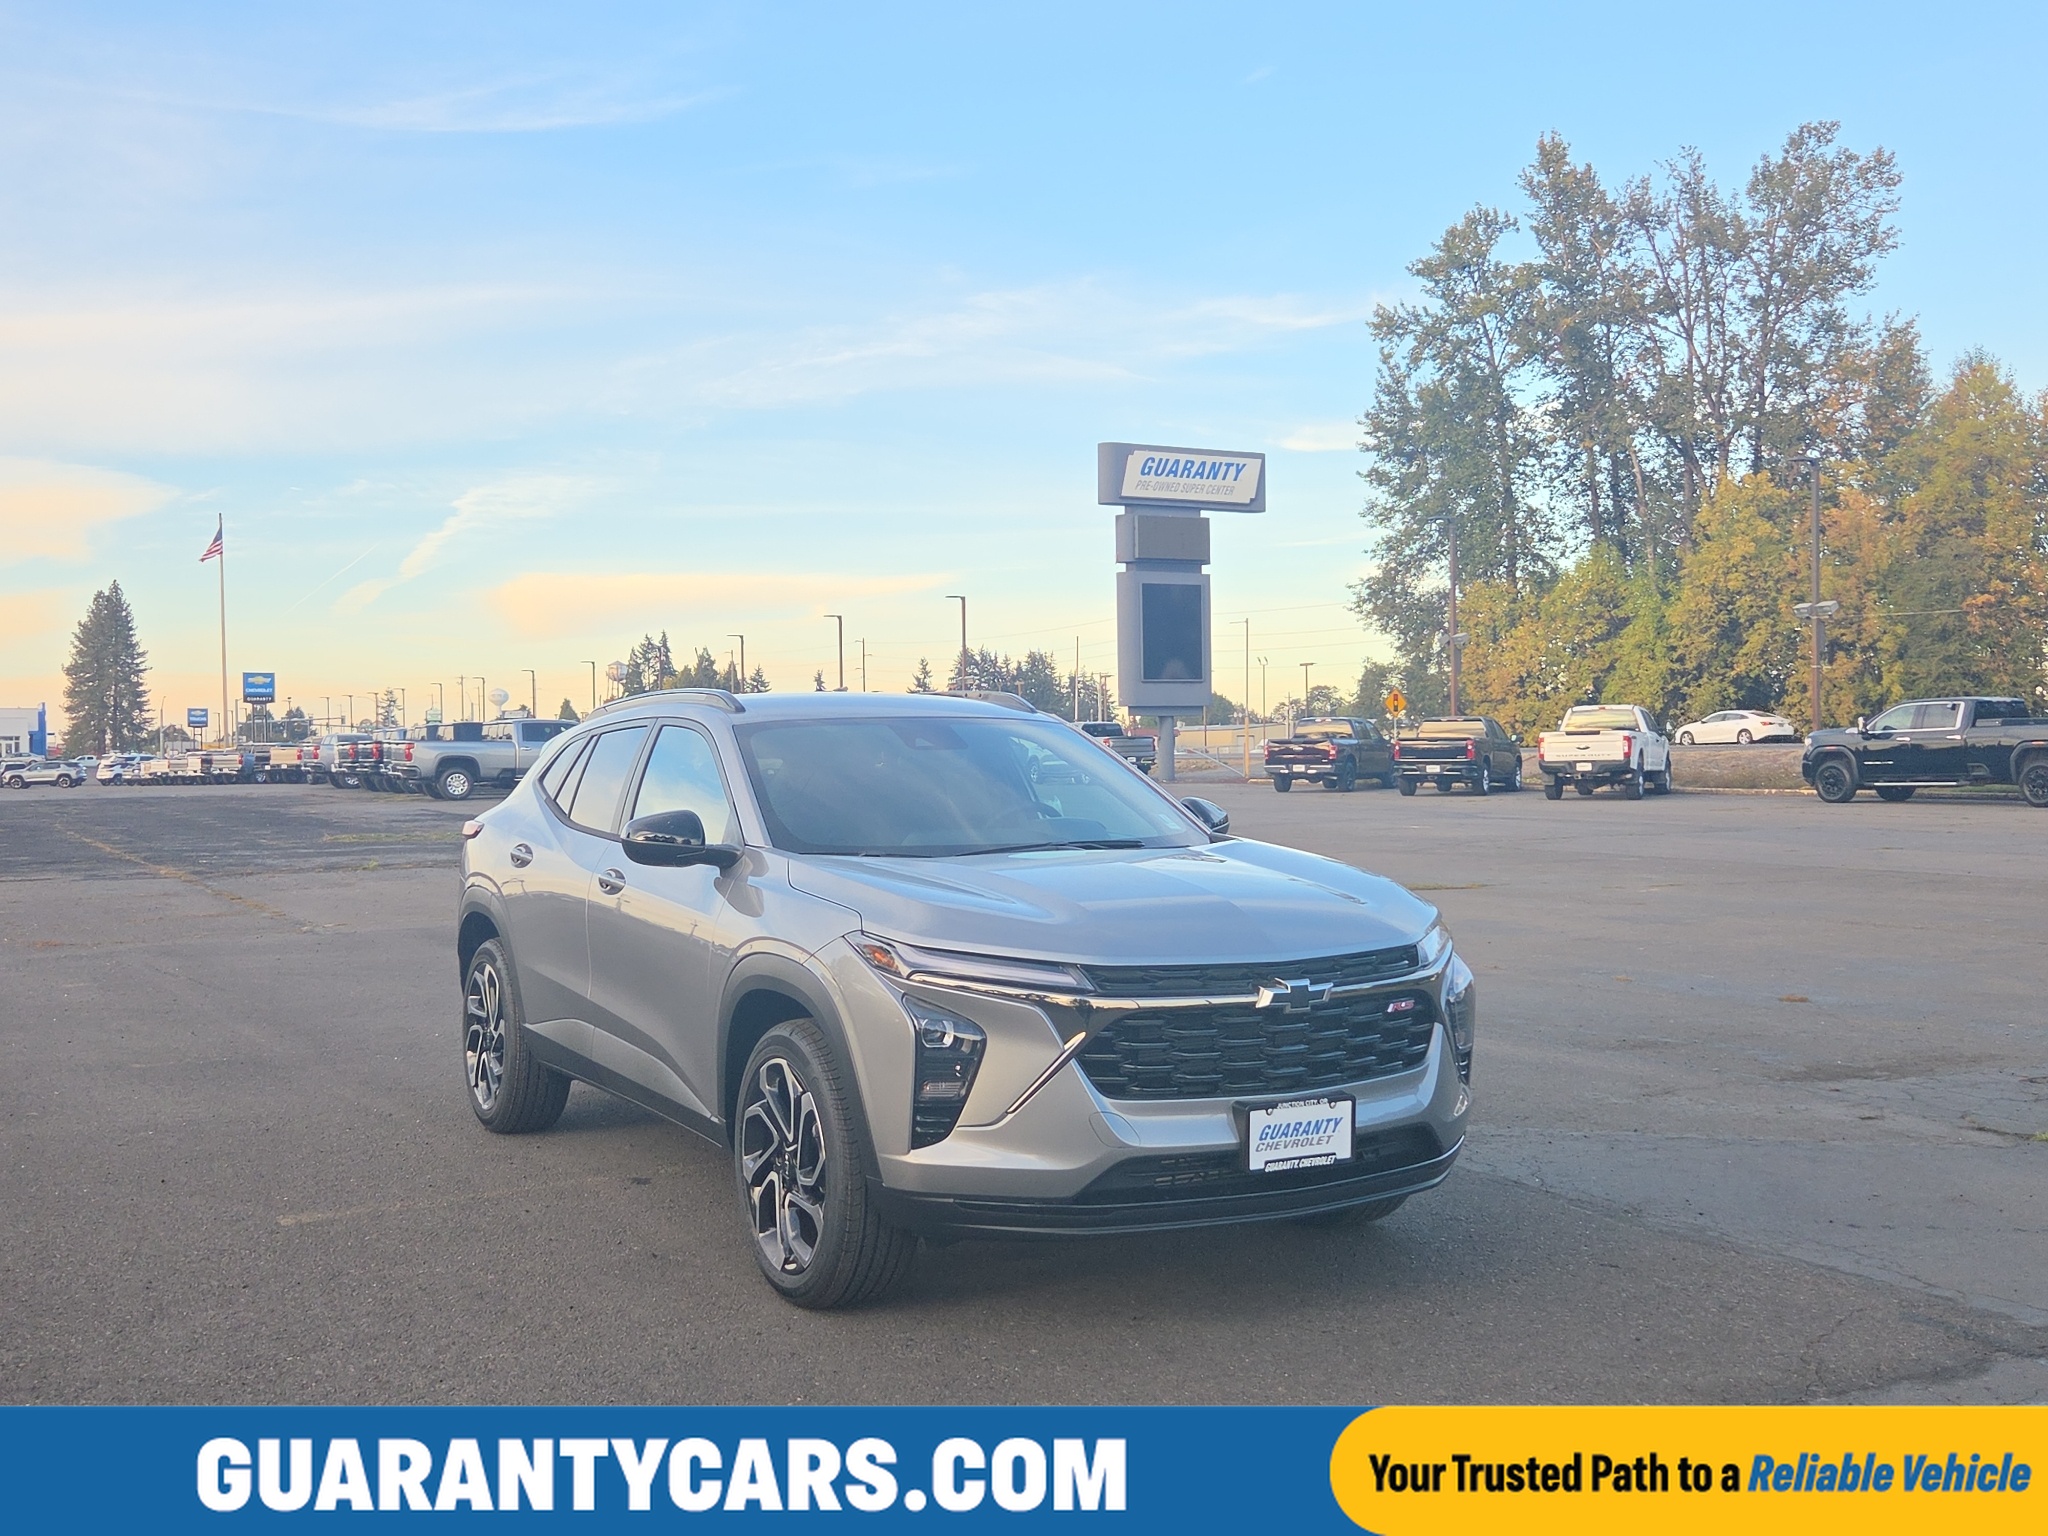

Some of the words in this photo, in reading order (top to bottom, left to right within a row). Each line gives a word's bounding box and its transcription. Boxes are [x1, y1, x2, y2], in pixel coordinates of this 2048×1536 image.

[1140, 457, 1247, 482] GUARANTY
[1135, 480, 1181, 493] PRE-OWNED
[1180, 483, 1204, 494] SUPER
[1206, 484, 1235, 496] CENTER
[1259, 1117, 1344, 1142] GUARANTY
[1255, 1135, 1334, 1153] CHEVROLET
[1265, 1160, 1300, 1173] GUARANTY
[1299, 1155, 1337, 1168] CHEVROLET
